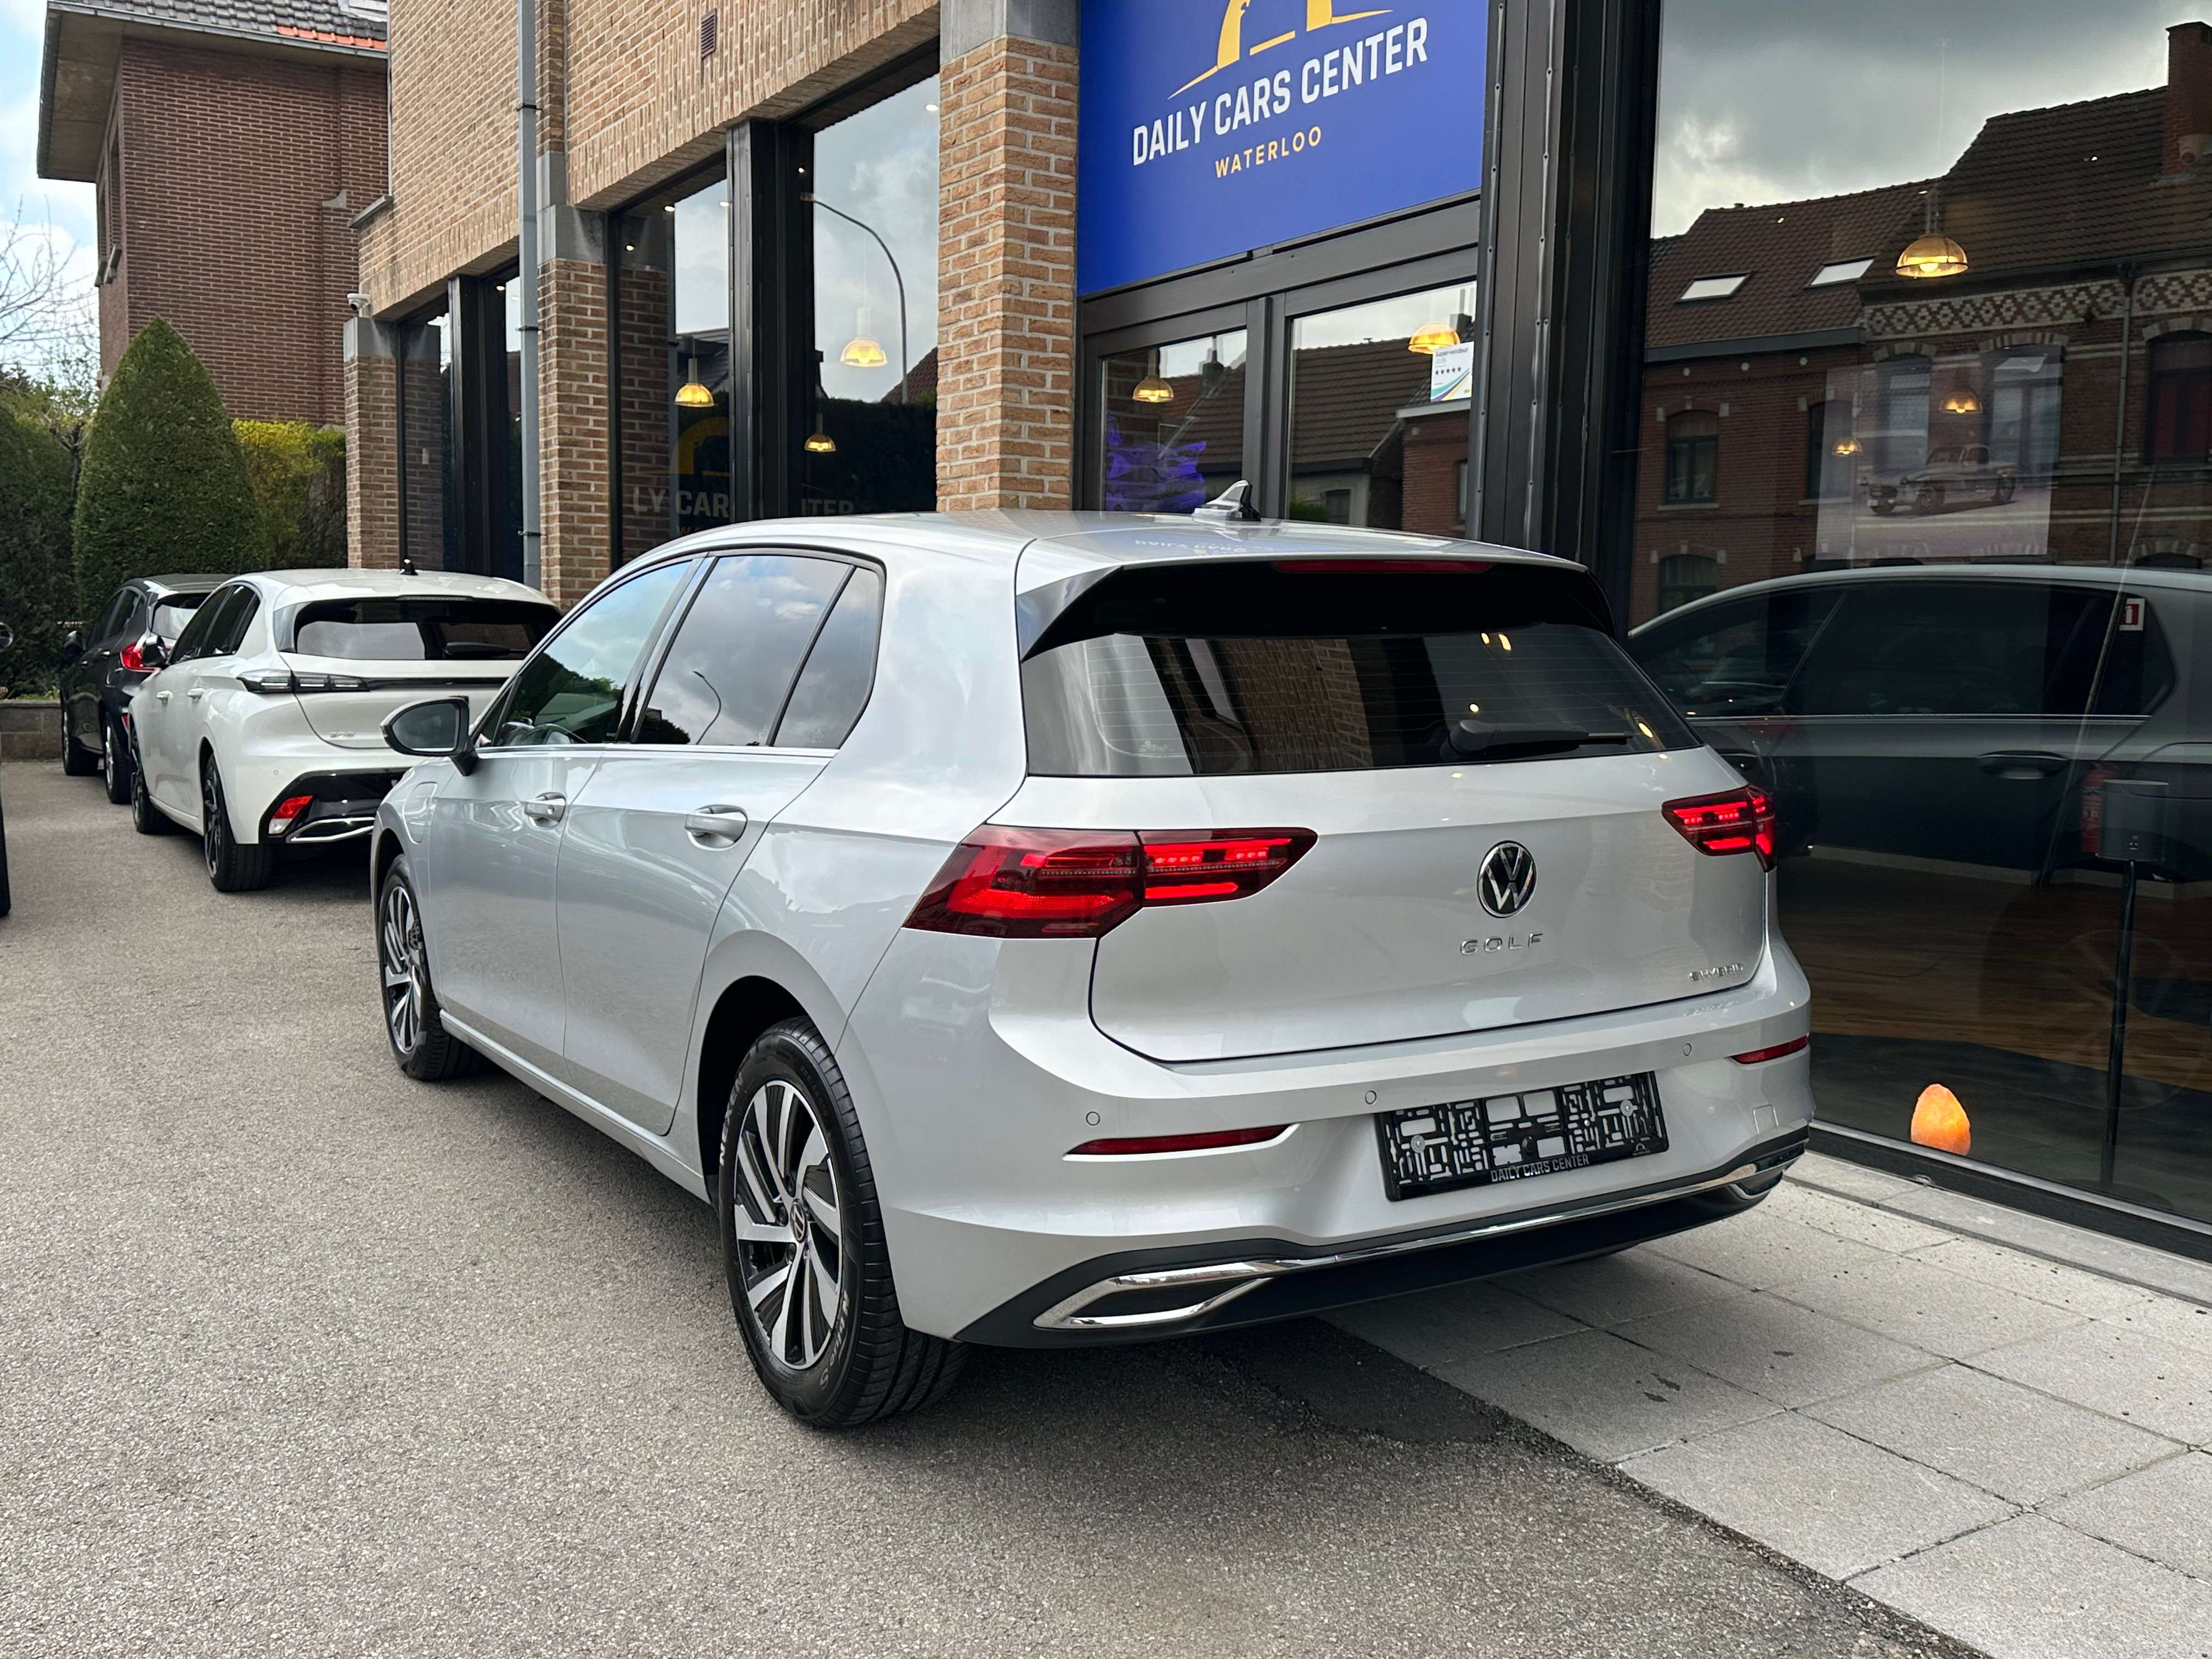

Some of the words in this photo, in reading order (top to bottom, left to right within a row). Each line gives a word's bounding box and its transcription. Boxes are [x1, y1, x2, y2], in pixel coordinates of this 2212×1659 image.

[1133, 101, 1207, 166] DAILY
[1214, 70, 1291, 136] CARS
[1301, 18, 1428, 104] CENTER
[1215, 126, 1322, 178] WATERLOO
[675, 490, 730, 518] CAR
[1460, 932, 1543, 956] GOLF
[719, 1071, 744, 1166] NEXEN
[1491, 1165, 1521, 1183] DAILY
[1523, 1160, 1550, 1176] CARS
[1552, 1154, 1589, 1171] CENTER
